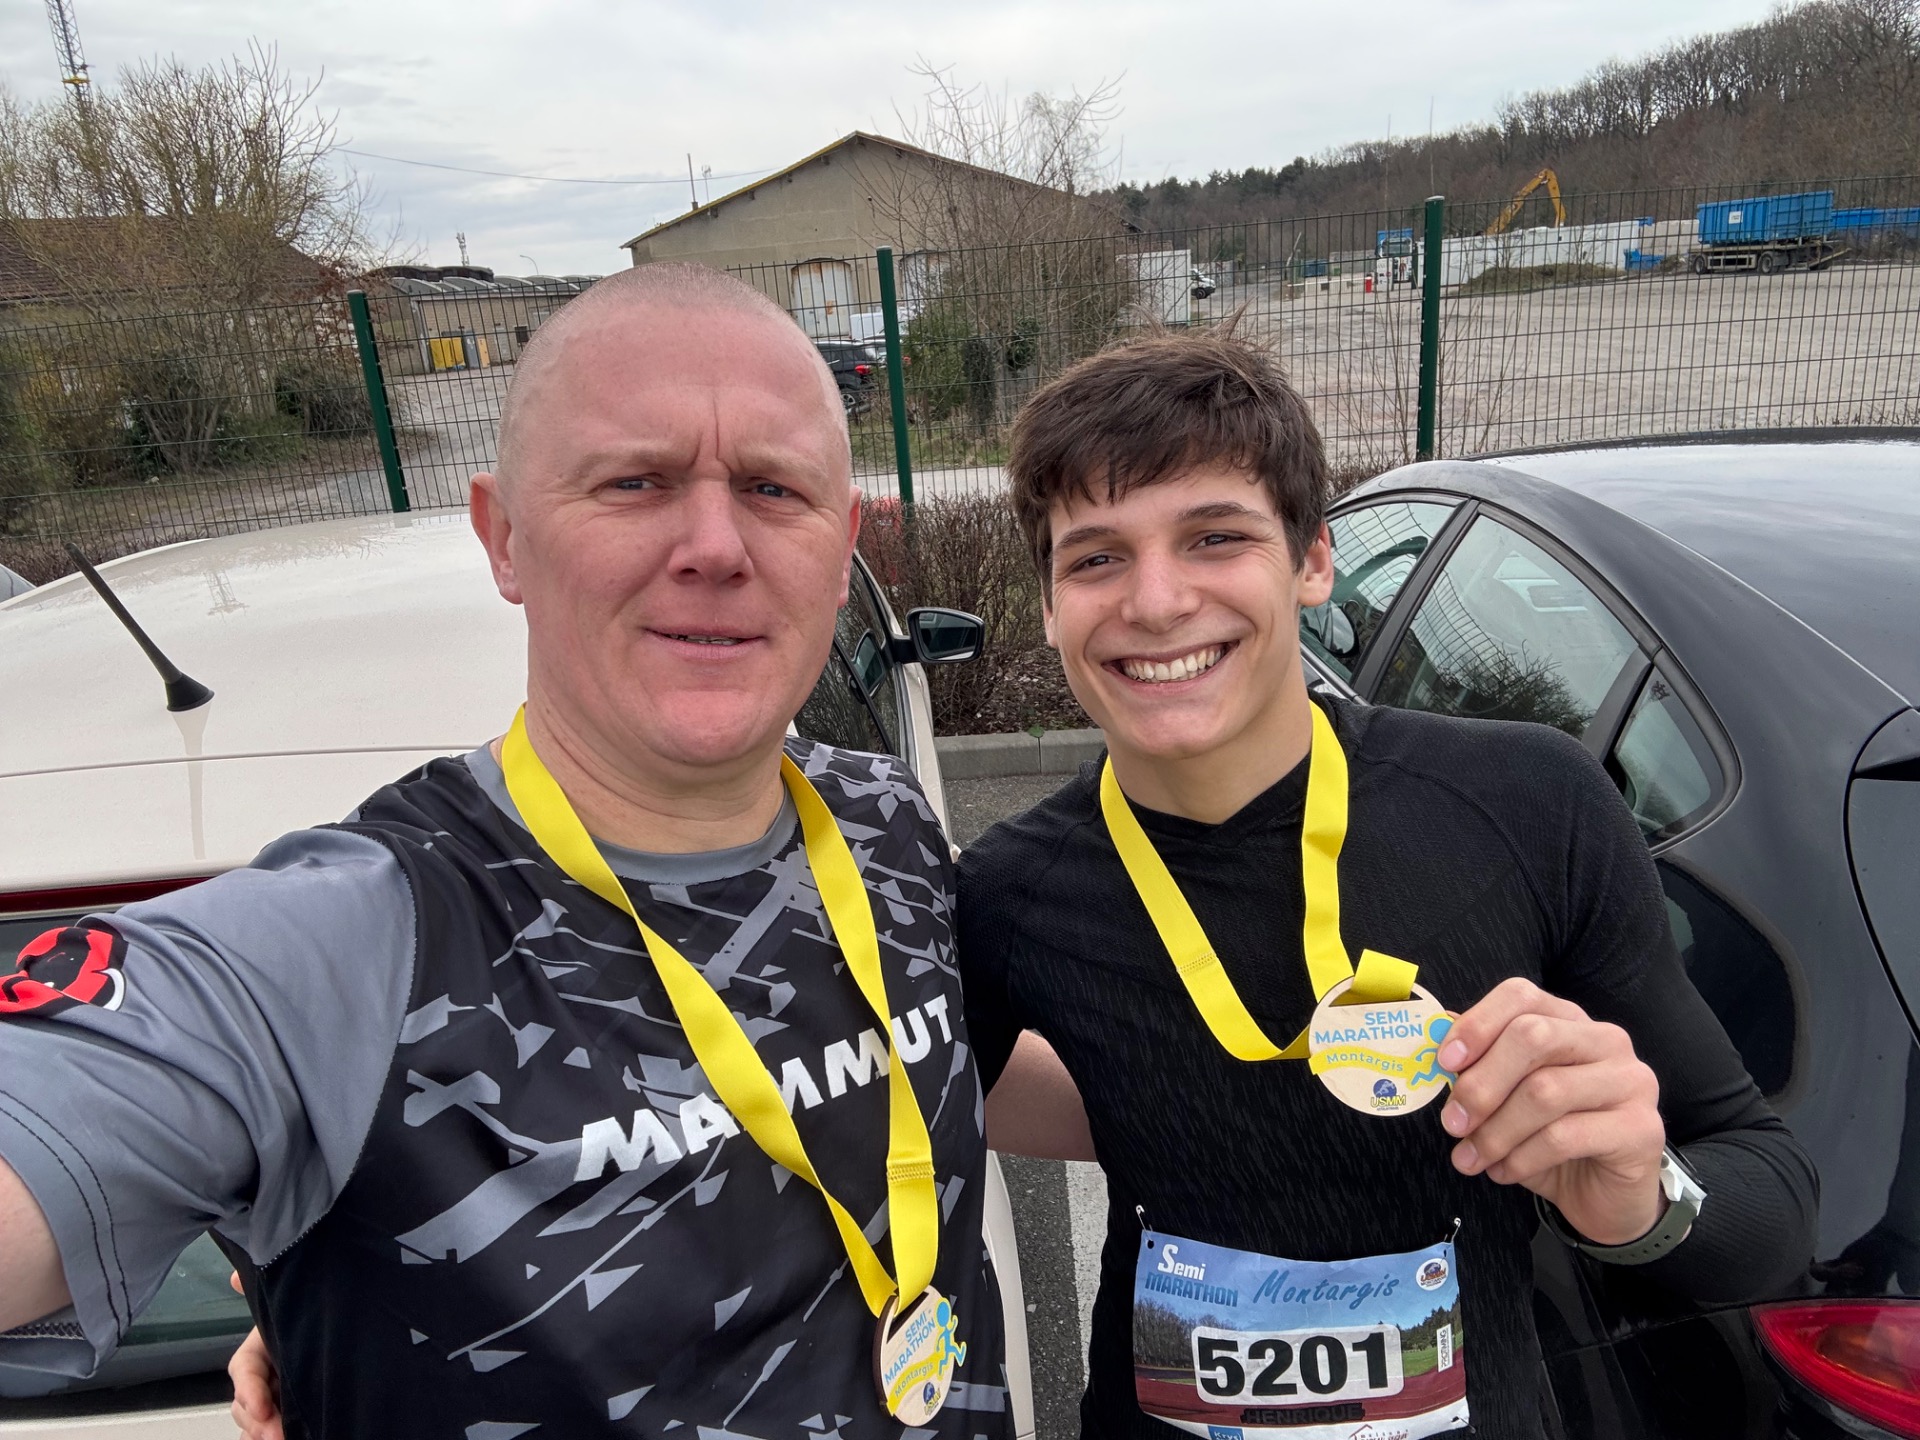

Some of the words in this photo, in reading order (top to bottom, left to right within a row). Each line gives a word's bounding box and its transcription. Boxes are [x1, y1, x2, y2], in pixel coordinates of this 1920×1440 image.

[1315, 1023, 1423, 1044] MARATHON
[1364, 1009, 1410, 1026] SEMI
[1326, 1052, 1404, 1072] Montargis
[1370, 1094, 1406, 1108] USMM
[1157, 1243, 1206, 1281] Semi
[1145, 1271, 1238, 1308] MARATHON
[1253, 1269, 1400, 1310] Montargis
[905, 1311, 927, 1342] SEMI
[884, 1318, 936, 1385] MARATHON
[1198, 1332, 1389, 1397] 5201
[895, 1362, 933, 1396] Montargis
[1246, 1403, 1363, 1424] HENRIQUE
